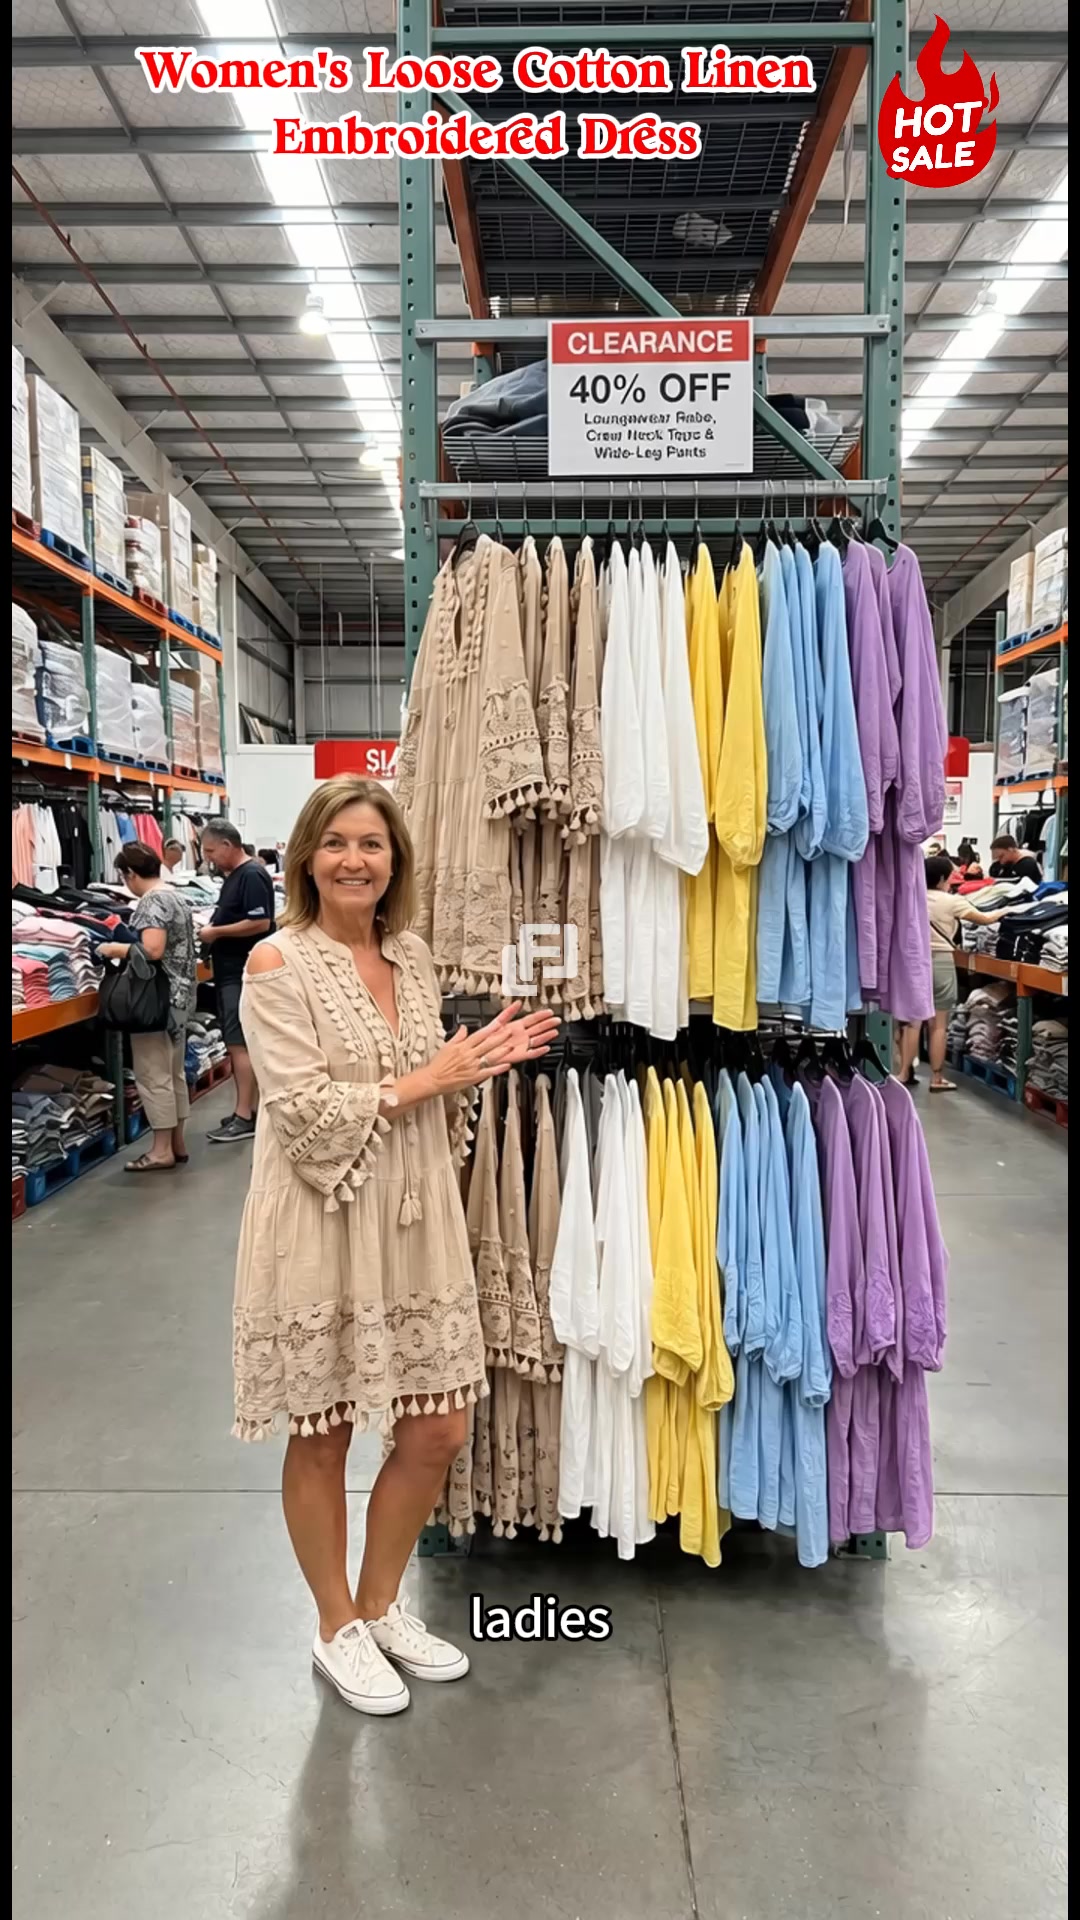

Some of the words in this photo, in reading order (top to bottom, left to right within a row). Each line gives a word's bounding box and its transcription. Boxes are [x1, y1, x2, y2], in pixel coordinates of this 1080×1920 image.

[567, 330, 733, 355] CLEARANCE
[569, 373, 646, 404] 40%
[659, 372, 731, 403] OFF
[704, 428, 715, 440] &
